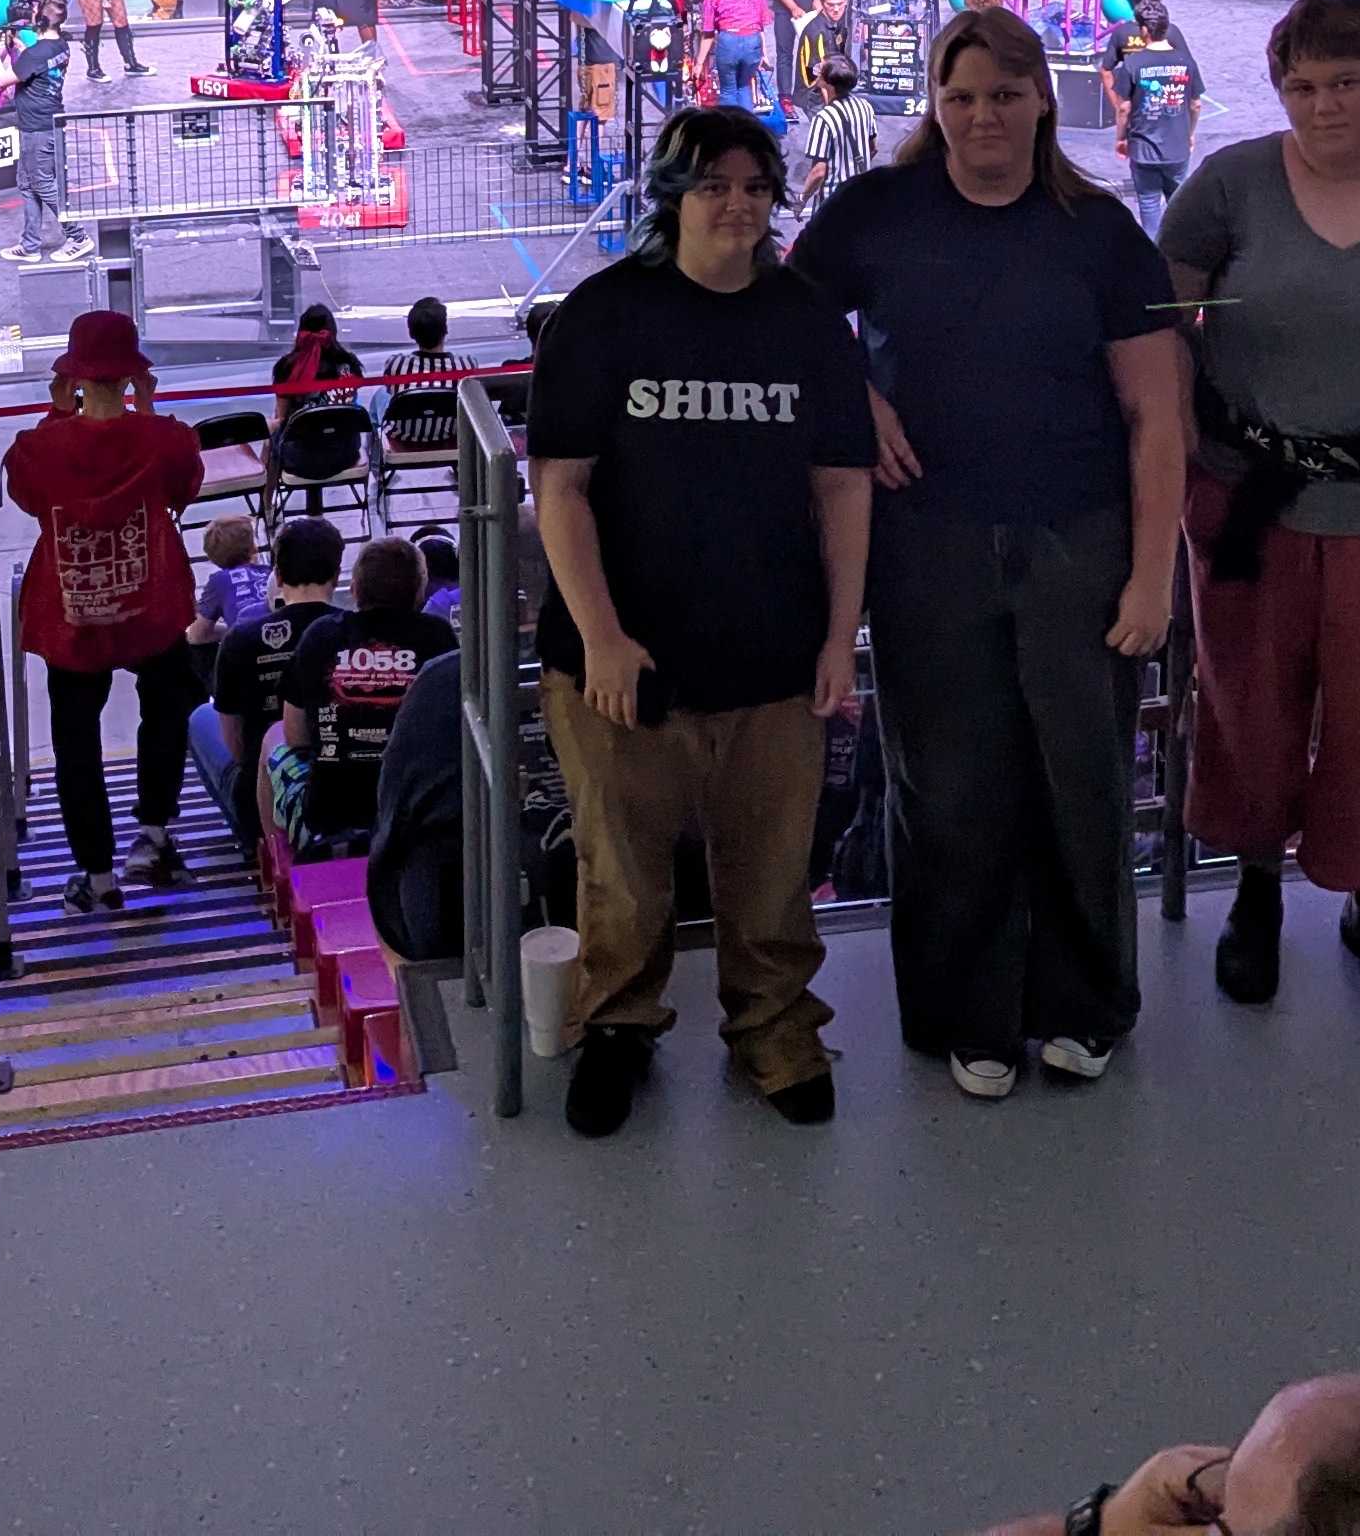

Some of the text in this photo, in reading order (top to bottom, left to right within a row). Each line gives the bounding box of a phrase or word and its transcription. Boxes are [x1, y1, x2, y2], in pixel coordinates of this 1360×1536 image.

[196, 79, 229, 98] 1591
[319, 211, 361, 228] 4041
[626, 378, 801, 424] SHIRT
[335, 647, 417, 672] 1058
